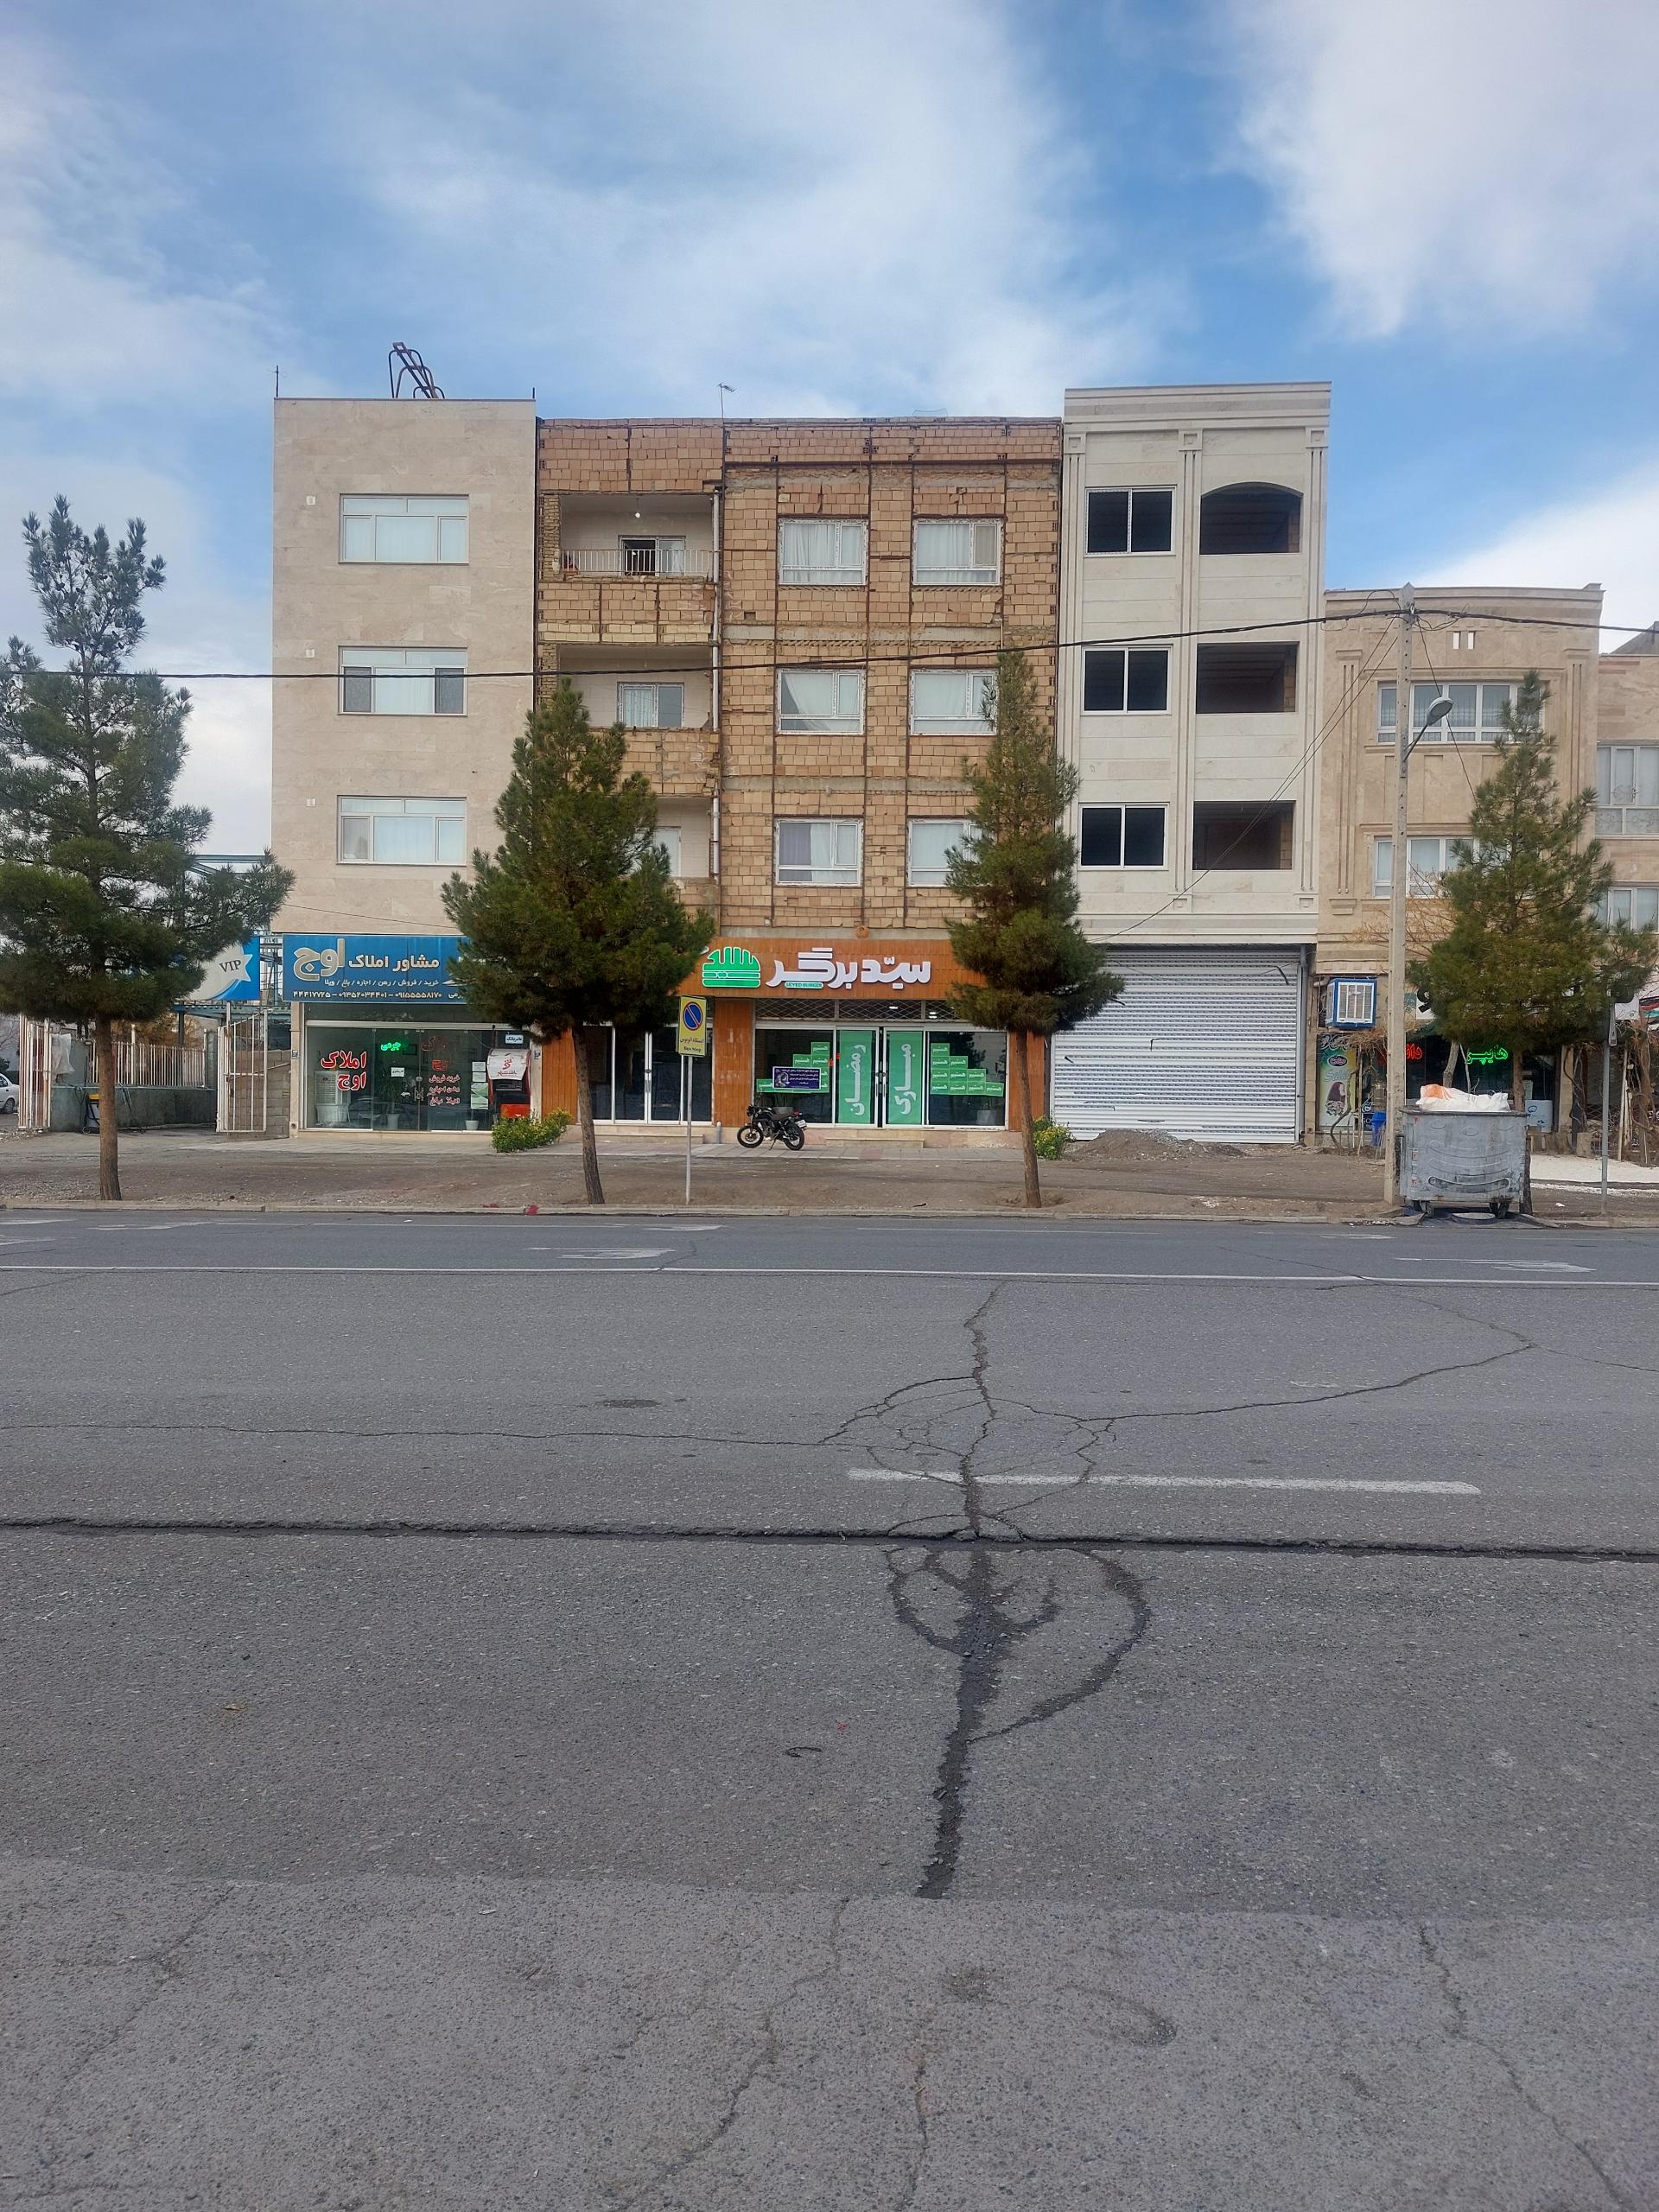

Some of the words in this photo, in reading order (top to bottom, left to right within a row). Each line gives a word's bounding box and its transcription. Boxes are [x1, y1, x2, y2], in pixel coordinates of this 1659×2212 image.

[219, 959, 242, 973] VIP
[293, 938, 346, 982] اوج
[348, 954, 389, 968] املاک
[392, 954, 440, 972] مشاور
[766, 947, 858, 989] برگر
[341, 979, 351, 988] باغ
[321, 1050, 367, 1070] املاک
[1467, 1044, 1509, 1065] هایپر
[336, 1071, 366, 1091] اوج
[844, 1044, 867, 1116] رمضان
[893, 1043, 917, 1115] مبارک
